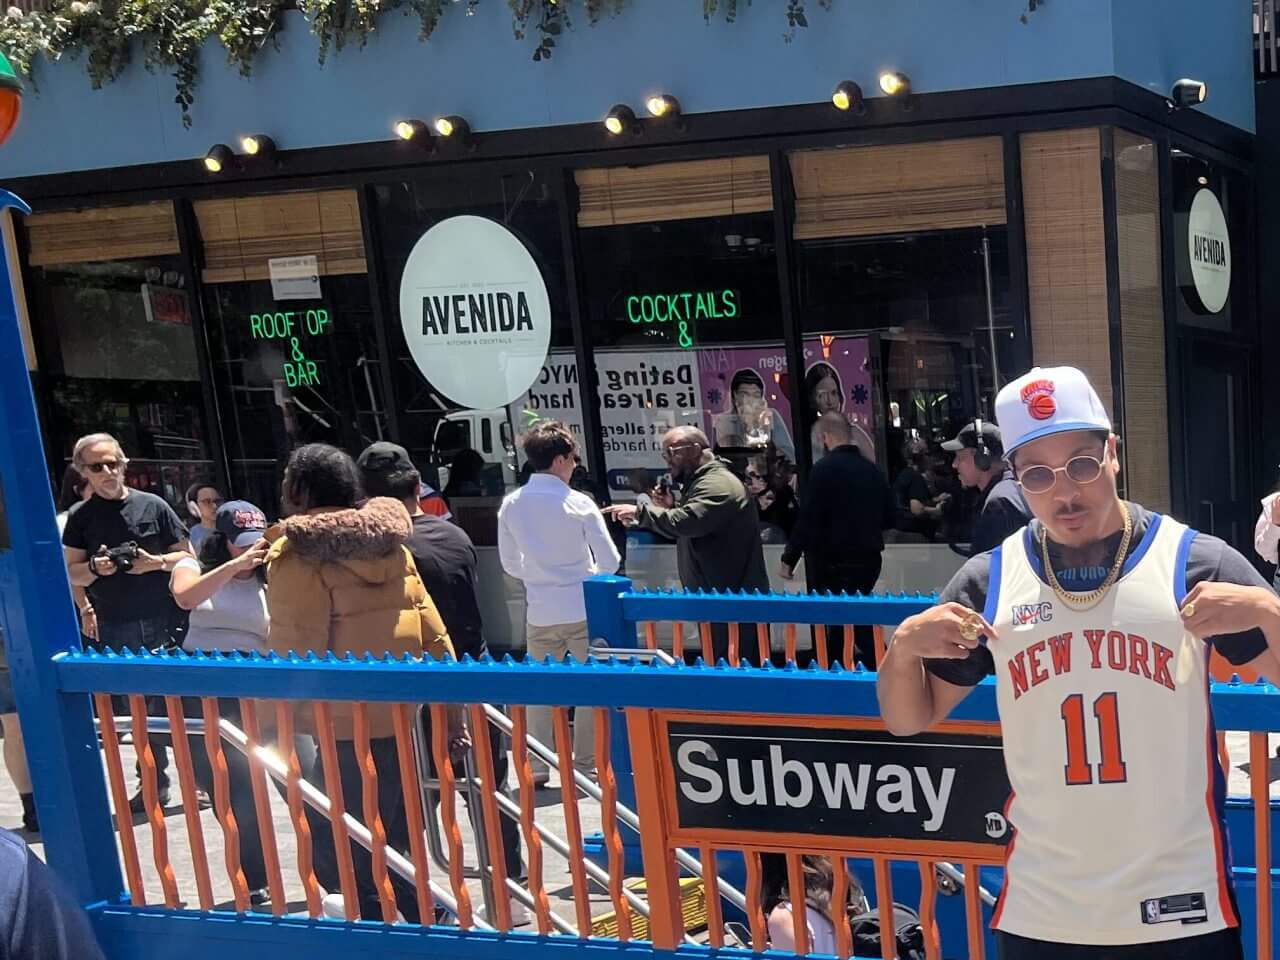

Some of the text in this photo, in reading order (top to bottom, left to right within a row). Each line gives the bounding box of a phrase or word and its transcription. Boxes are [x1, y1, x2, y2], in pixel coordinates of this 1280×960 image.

[1194, 235, 1226, 267] AVENIDA
[422, 291, 534, 335] AVENIDA
[627, 290, 737, 323] COCKTAILS
[290, 336, 304, 361] &
[678, 321, 693, 348] &
[283, 361, 321, 388] BAR
[1012, 602, 1052, 625] NYC
[1007, 629, 1176, 701] NEW YORK
[1060, 691, 1128, 786] 11
[676, 740, 956, 831] Subway
